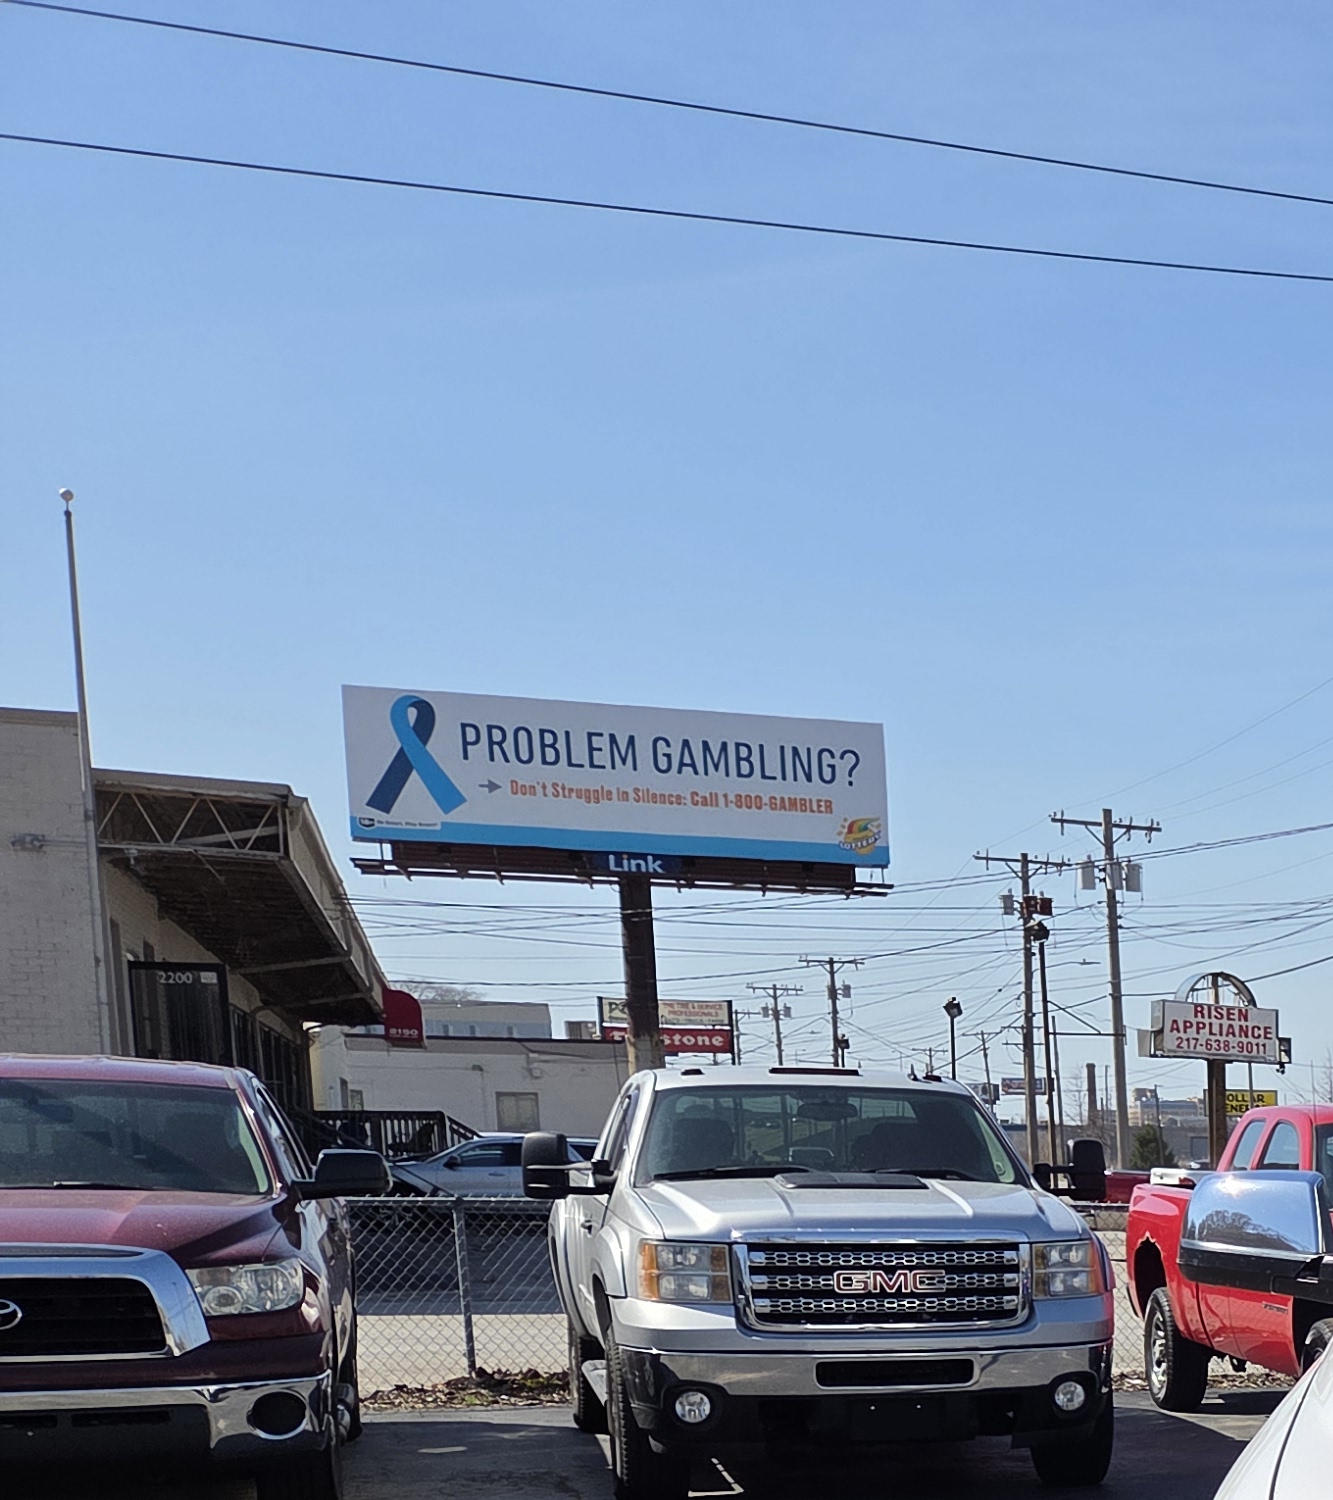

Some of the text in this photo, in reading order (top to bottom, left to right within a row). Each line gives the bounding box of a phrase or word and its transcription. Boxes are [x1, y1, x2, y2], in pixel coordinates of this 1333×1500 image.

[461, 722, 860, 787] PROBLEM GAMBLING?
[510, 779, 548, 797] Don't
[551, 782, 613, 804] Struggle
[617, 786, 629, 802] in
[691, 791, 719, 808] Call
[722, 792, 833, 815] 1-800-GAMBLER
[608, 854, 667, 874] Link
[159, 971, 193, 984] 2200
[1193, 1005, 1249, 1022] RISEN
[1170, 1020, 1273, 1040] APPLIANCE
[1176, 1037, 1268, 1055] 217-638-9011
[1226, 1093, 1266, 1103] OLLAR
[833, 1269, 946, 1293] GMC
